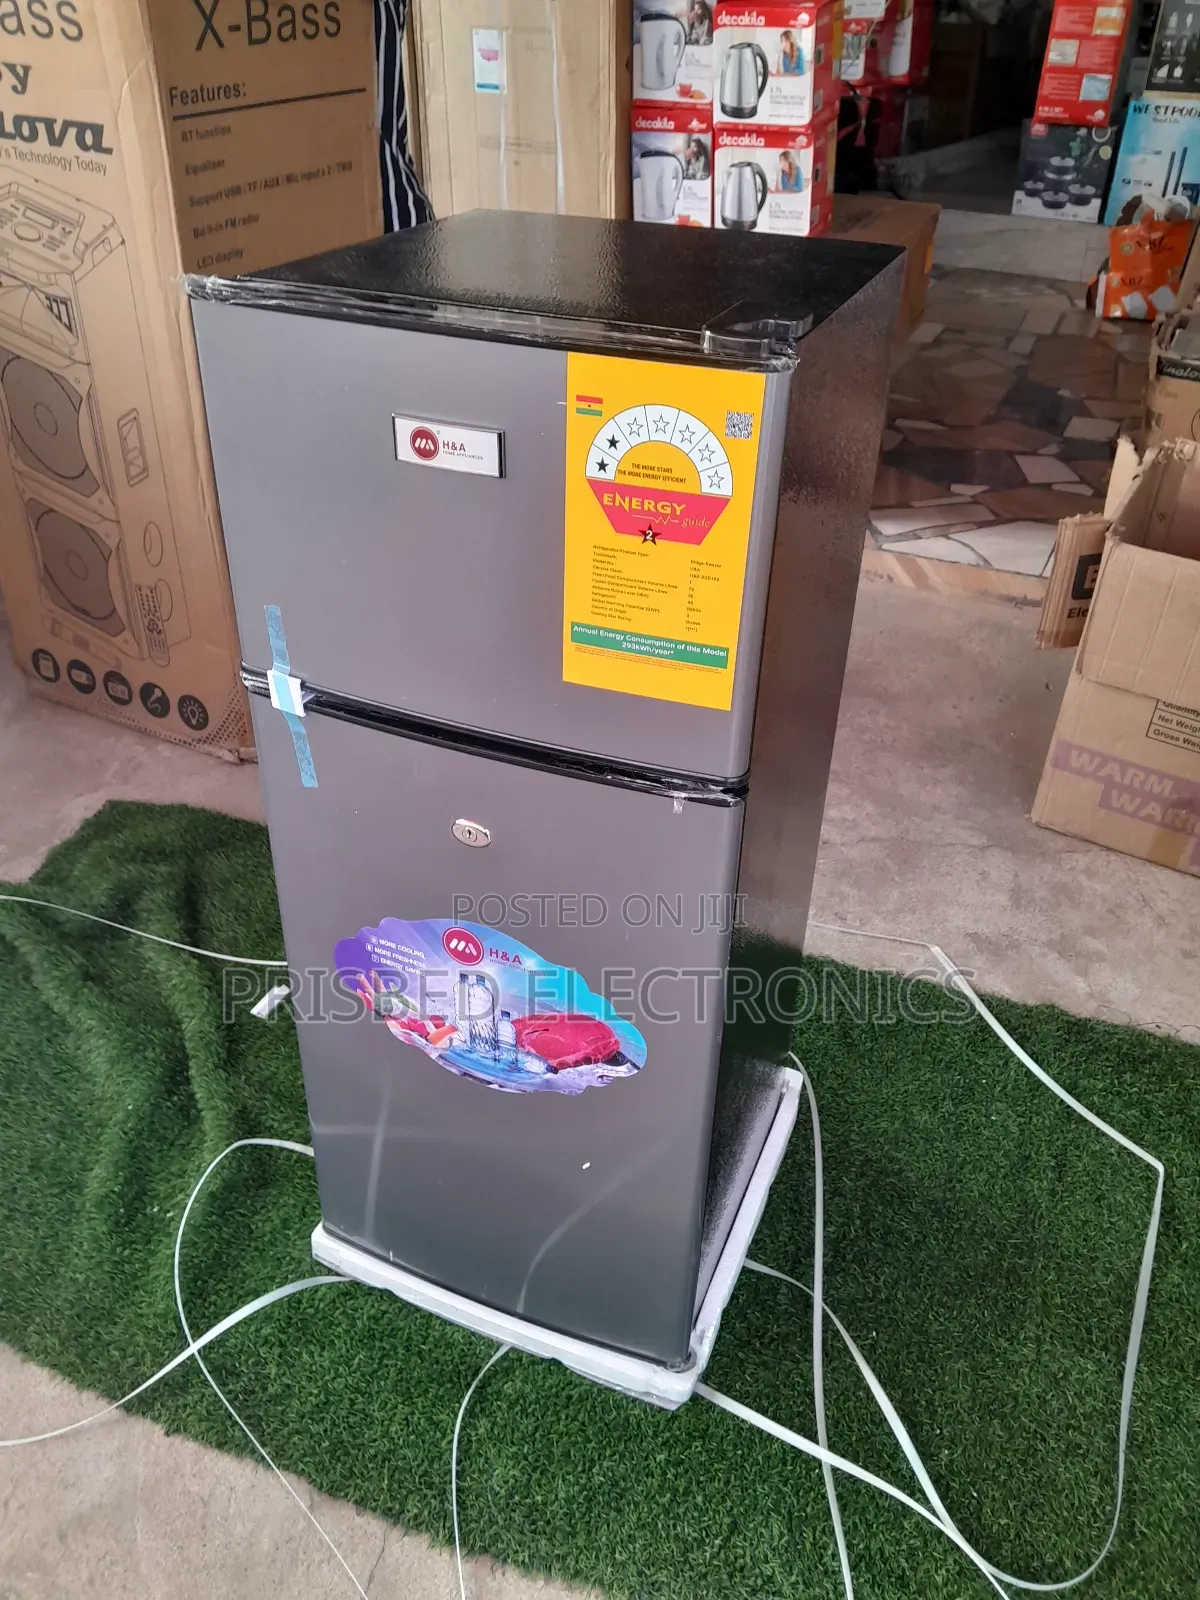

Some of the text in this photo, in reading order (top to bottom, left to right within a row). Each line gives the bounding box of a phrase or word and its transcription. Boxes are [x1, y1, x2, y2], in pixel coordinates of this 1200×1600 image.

[192, 0, 341, 51] X-Bass
[717, 10, 765, 26] decakila
[0, 61, 32, 95] y
[168, 81, 247, 107] Features:
[635, 116, 675, 130] decakila
[718, 131, 765, 147] decakila
[12, 146, 73, 172] Technology
[74, 155, 107, 177] Today
[188, 190, 223, 208] Support
[225, 216, 237, 230] FM
[238, 214, 260, 227] radio
[215, 246, 245, 265] display
[442, 439, 467, 453] H&A
[631, 462, 673, 474] THE MORE STARS
[627, 470, 642, 478] MORE
[642, 472, 662, 481] ENERGY
[661, 474, 687, 484] EFFICIENT
[602, 491, 687, 516] ENERGY
[681, 516, 711, 528] guide
[645, 529, 654, 541] 2
[573, 625, 727, 657] Annual Energy Consumption of this Model
[1158, 714, 1174, 725] Net
[1153, 728, 1181, 742] Gross
[374, 946, 392, 958] MORE
[379, 938, 397, 950] MORE
[380, 957, 404, 970] ENERGY
[489, 947, 523, 966] H&A
